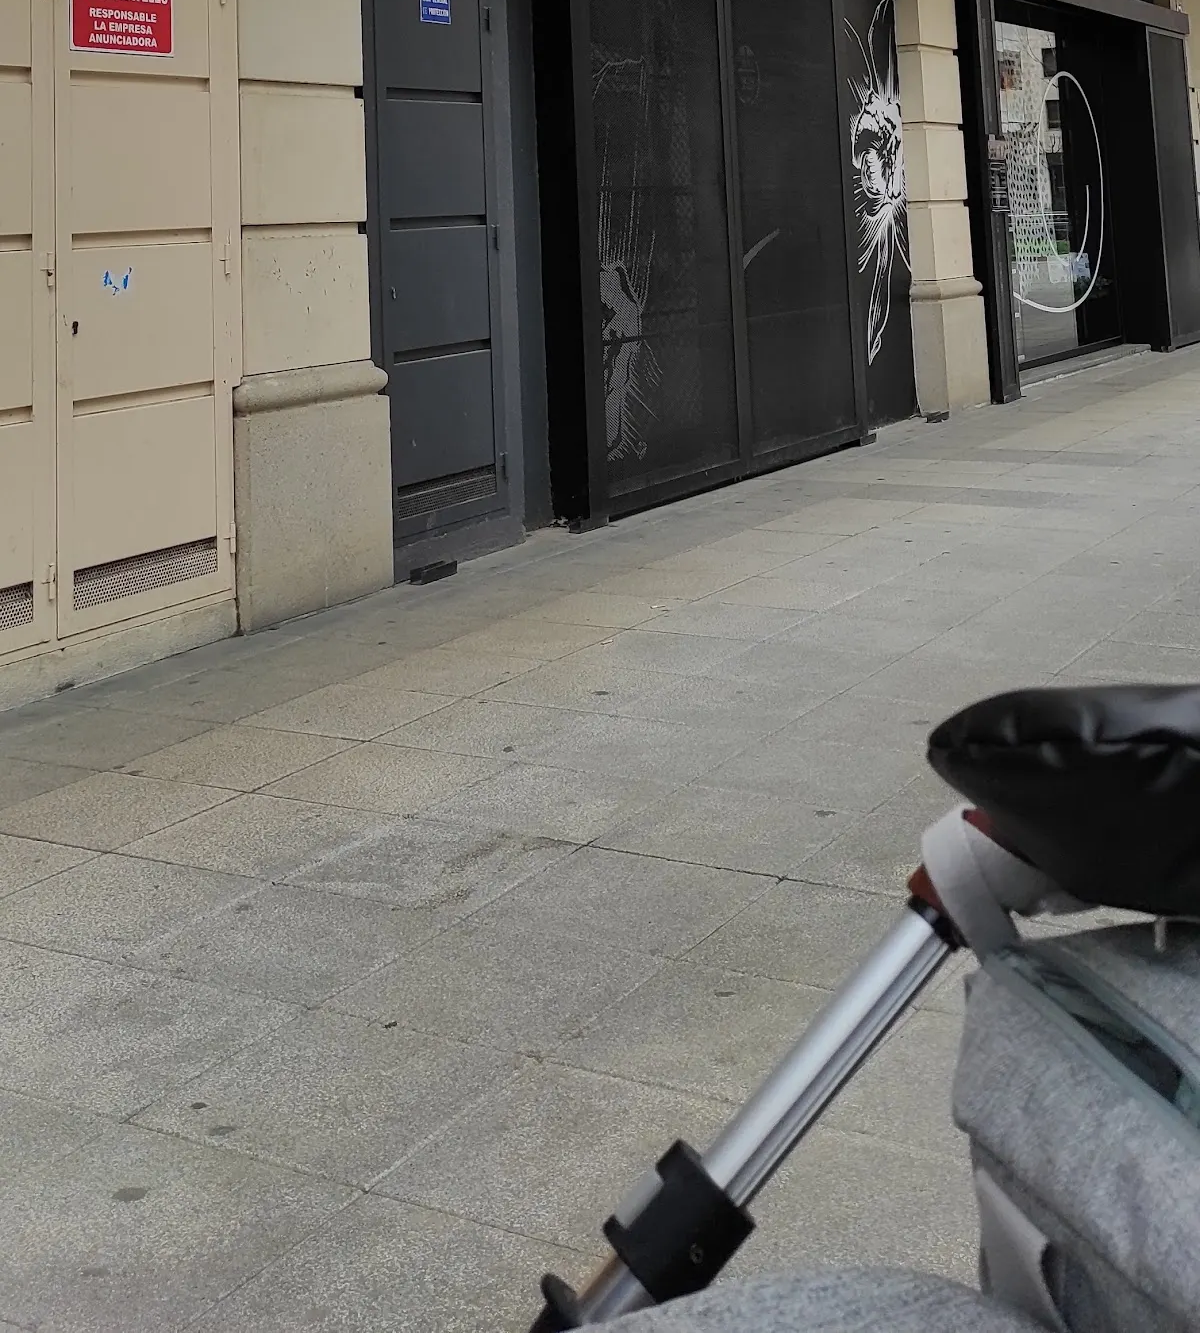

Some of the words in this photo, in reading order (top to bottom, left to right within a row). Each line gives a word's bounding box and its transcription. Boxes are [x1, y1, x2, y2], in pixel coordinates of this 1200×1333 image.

[89, 7, 157, 23] RESPONSABLE
[94, 20, 107, 32] LA
[109, 22, 153, 35] EMPRESA
[89, 33, 158, 48] ANUNCIADORA
